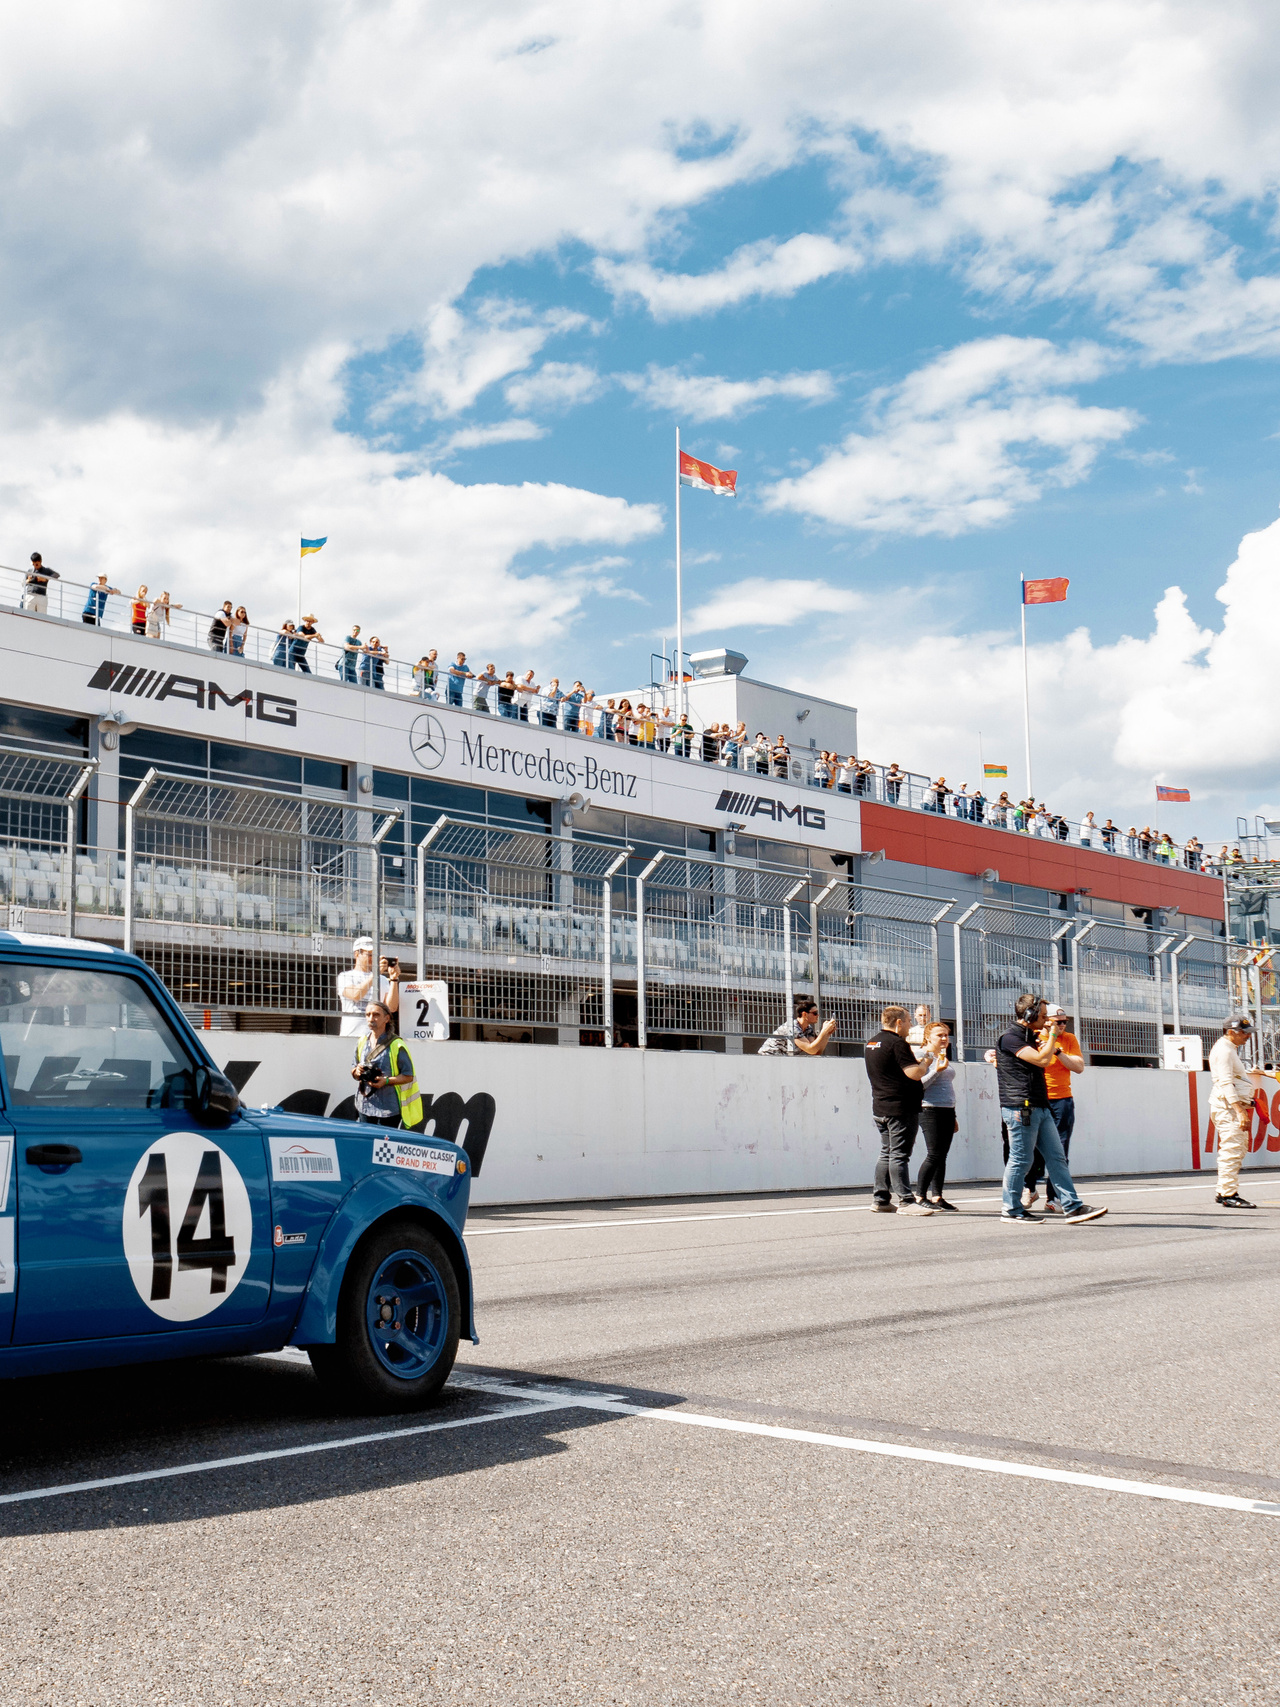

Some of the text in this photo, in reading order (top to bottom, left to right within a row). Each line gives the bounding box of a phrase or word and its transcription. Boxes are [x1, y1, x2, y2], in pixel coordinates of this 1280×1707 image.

[155, 673, 297, 727] AMG
[460, 730, 638, 798] Mercedes-Benz
[750, 796, 825, 830] AMG
[10, 909, 23, 928] 14
[312, 937, 323, 953] 15
[541, 957, 550, 972] 16
[416, 999, 429, 1026] 2
[413, 1030, 434, 1039] ROW
[1177, 1045, 1186, 1063] 1
[396, 1145, 455, 1163] MOSCOW CLASSIC
[395, 1156, 438, 1171] GRAND PRIX
[138, 1150, 236, 1301] 14
